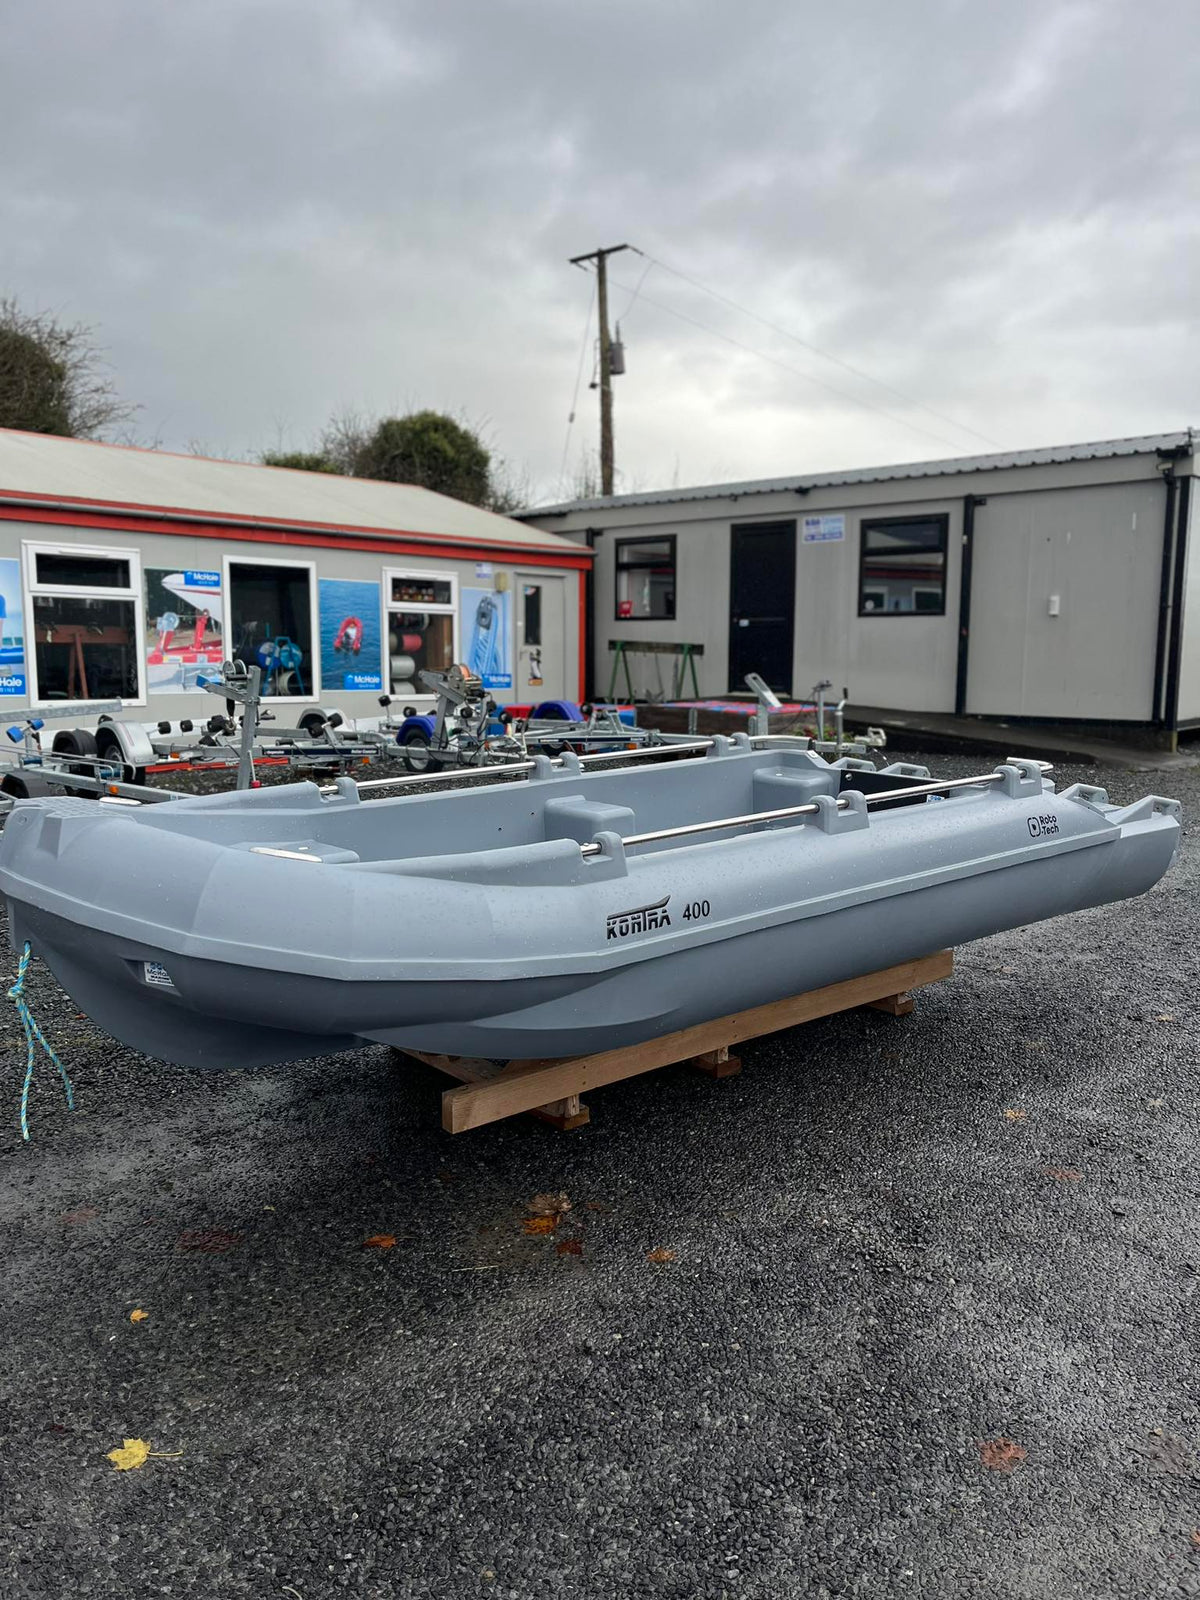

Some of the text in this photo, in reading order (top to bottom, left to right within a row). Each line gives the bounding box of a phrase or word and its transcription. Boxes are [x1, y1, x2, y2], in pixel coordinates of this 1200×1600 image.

[0, 677, 22, 686] Hale
[354, 675, 380, 684] McHale
[1039, 814, 1057, 825] Roto
[683, 900, 710, 920] 400
